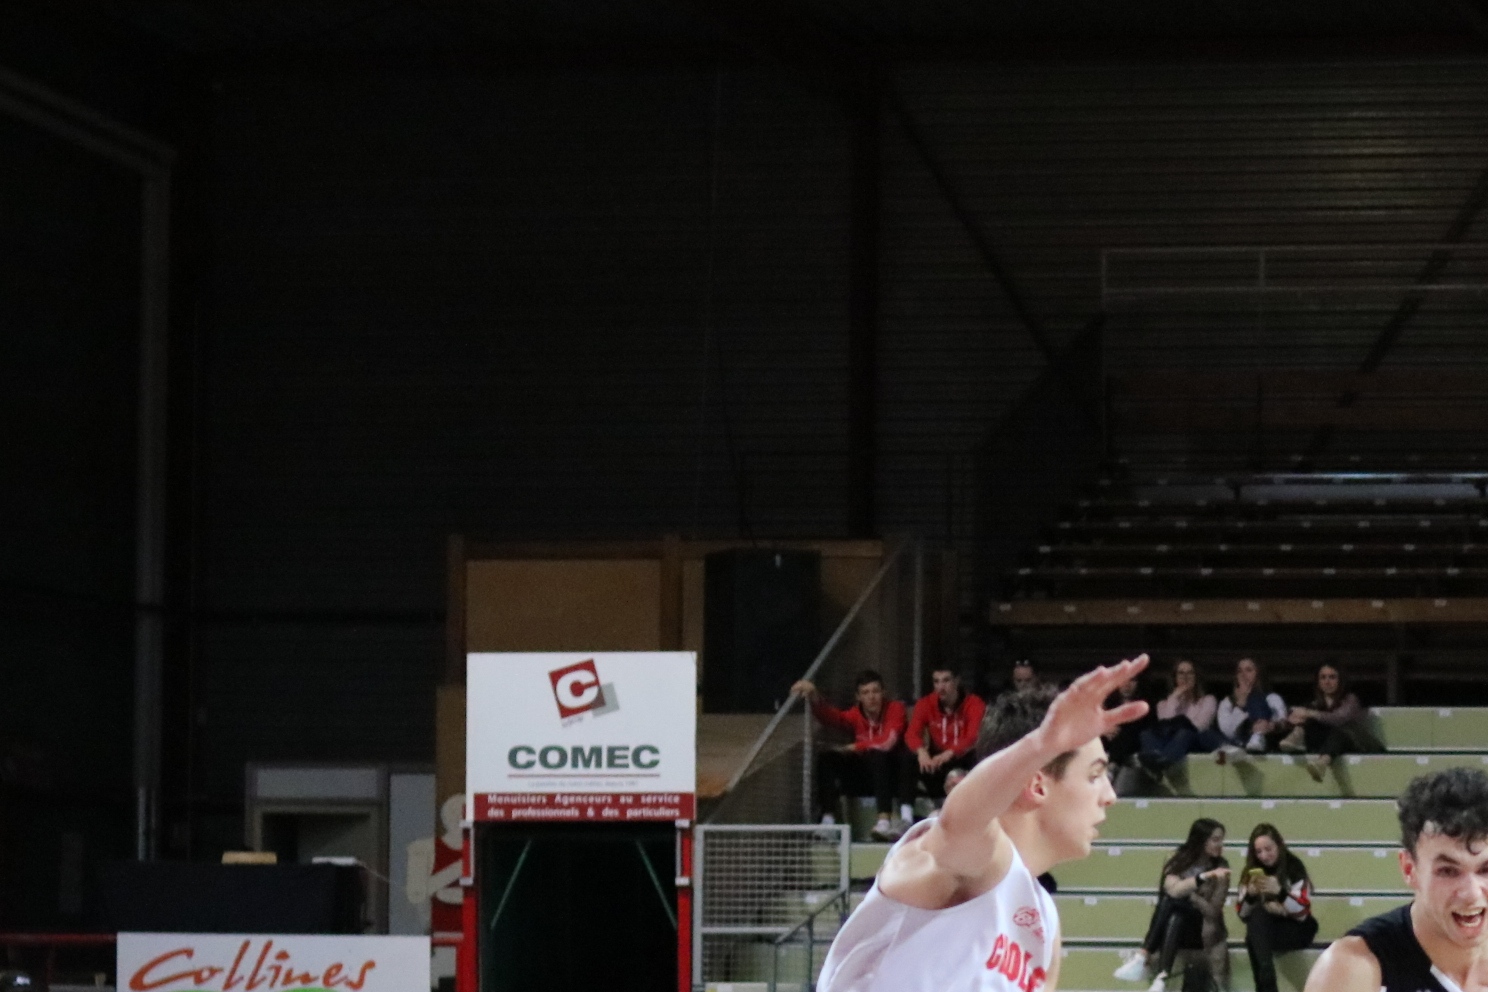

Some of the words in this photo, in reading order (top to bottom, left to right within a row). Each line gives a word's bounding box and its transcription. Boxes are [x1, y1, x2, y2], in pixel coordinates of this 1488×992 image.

[508, 745, 660, 769] COMEC
[488, 794, 547, 804] Menuisiers
[555, 794, 612, 805] Agenceurs
[619, 796, 634, 804] au
[641, 794, 680, 804] service
[488, 807, 504, 817] des
[512, 807, 579, 819] professionnels
[602, 807, 619, 817] des
[626, 807, 680, 819] particuliers
[128, 939, 376, 992] Collines
